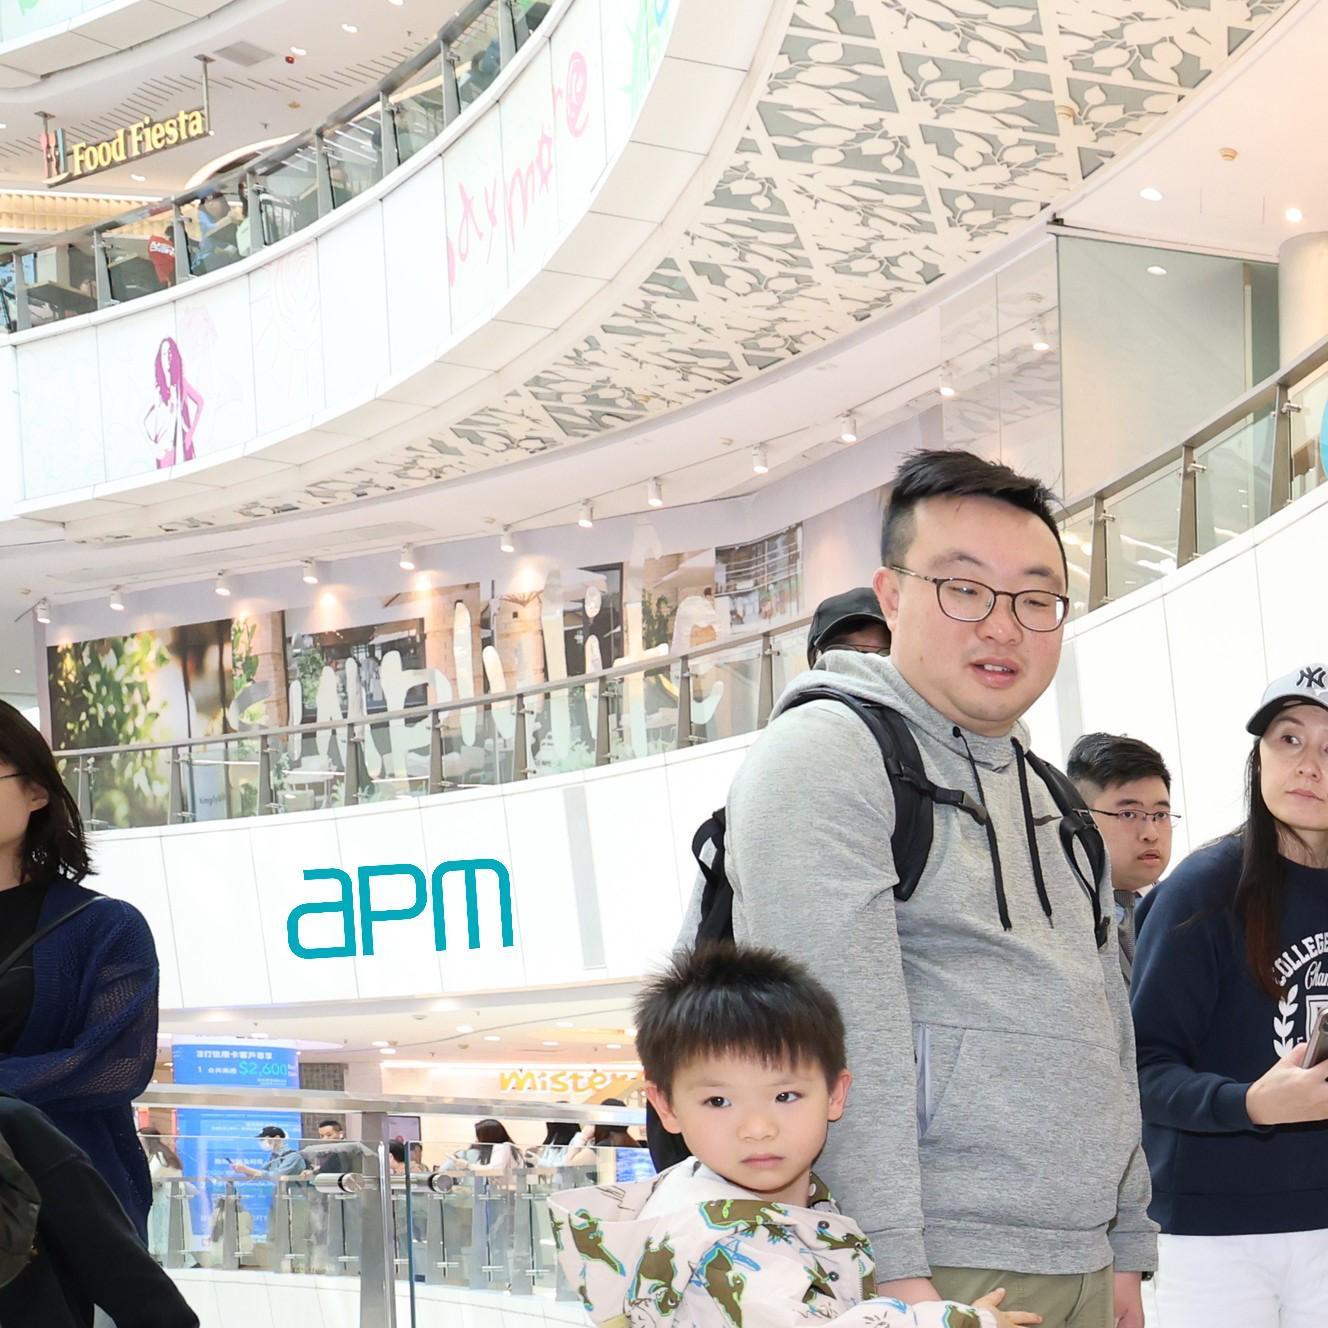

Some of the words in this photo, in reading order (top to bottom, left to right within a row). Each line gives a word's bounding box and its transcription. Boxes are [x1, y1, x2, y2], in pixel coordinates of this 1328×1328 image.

[71, 128, 127, 177] Food
[129, 109, 204, 157] Fiesta
[1296, 666, 1327, 688] NY
